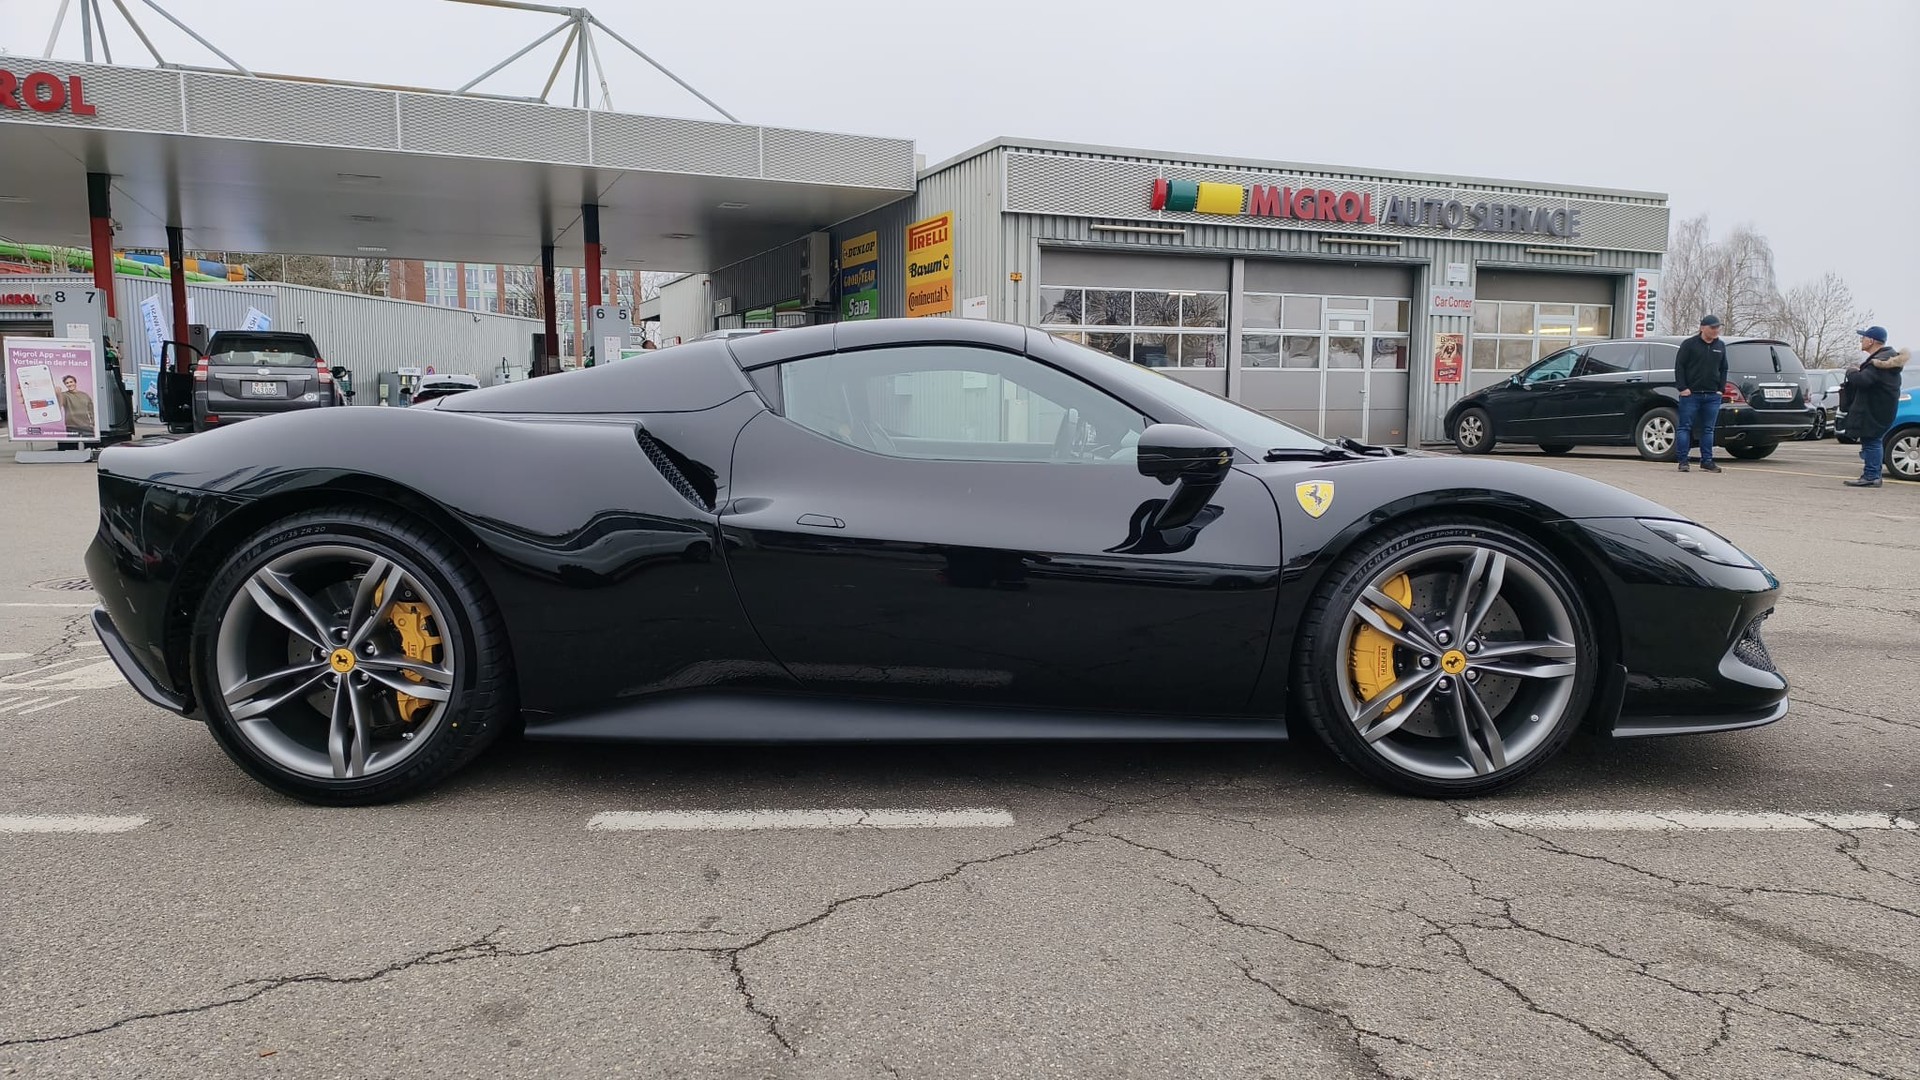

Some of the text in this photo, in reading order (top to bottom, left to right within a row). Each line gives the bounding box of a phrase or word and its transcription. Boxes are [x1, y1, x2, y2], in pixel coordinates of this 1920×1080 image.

[1251, 184, 1581, 237] MIGROL AUTO SERVICE
[909, 216, 948, 252] PIRELLI
[847, 241, 876, 258] DUNLOP
[844, 268, 876, 287] GOODYEAR
[908, 260, 942, 278] Barum
[0, 293, 37, 305] IGROL
[55, 291, 65, 302] 8
[85, 292, 95, 303] 7
[909, 286, 943, 311] Continental
[596, 308, 627, 320] 6 5
[849, 299, 870, 317] Sava
[1646, 289, 1657, 331] AUTO
[194, 326, 201, 335] 3
[39, 351, 54, 359] App
[1354, 539, 1409, 581] MICHELIN
